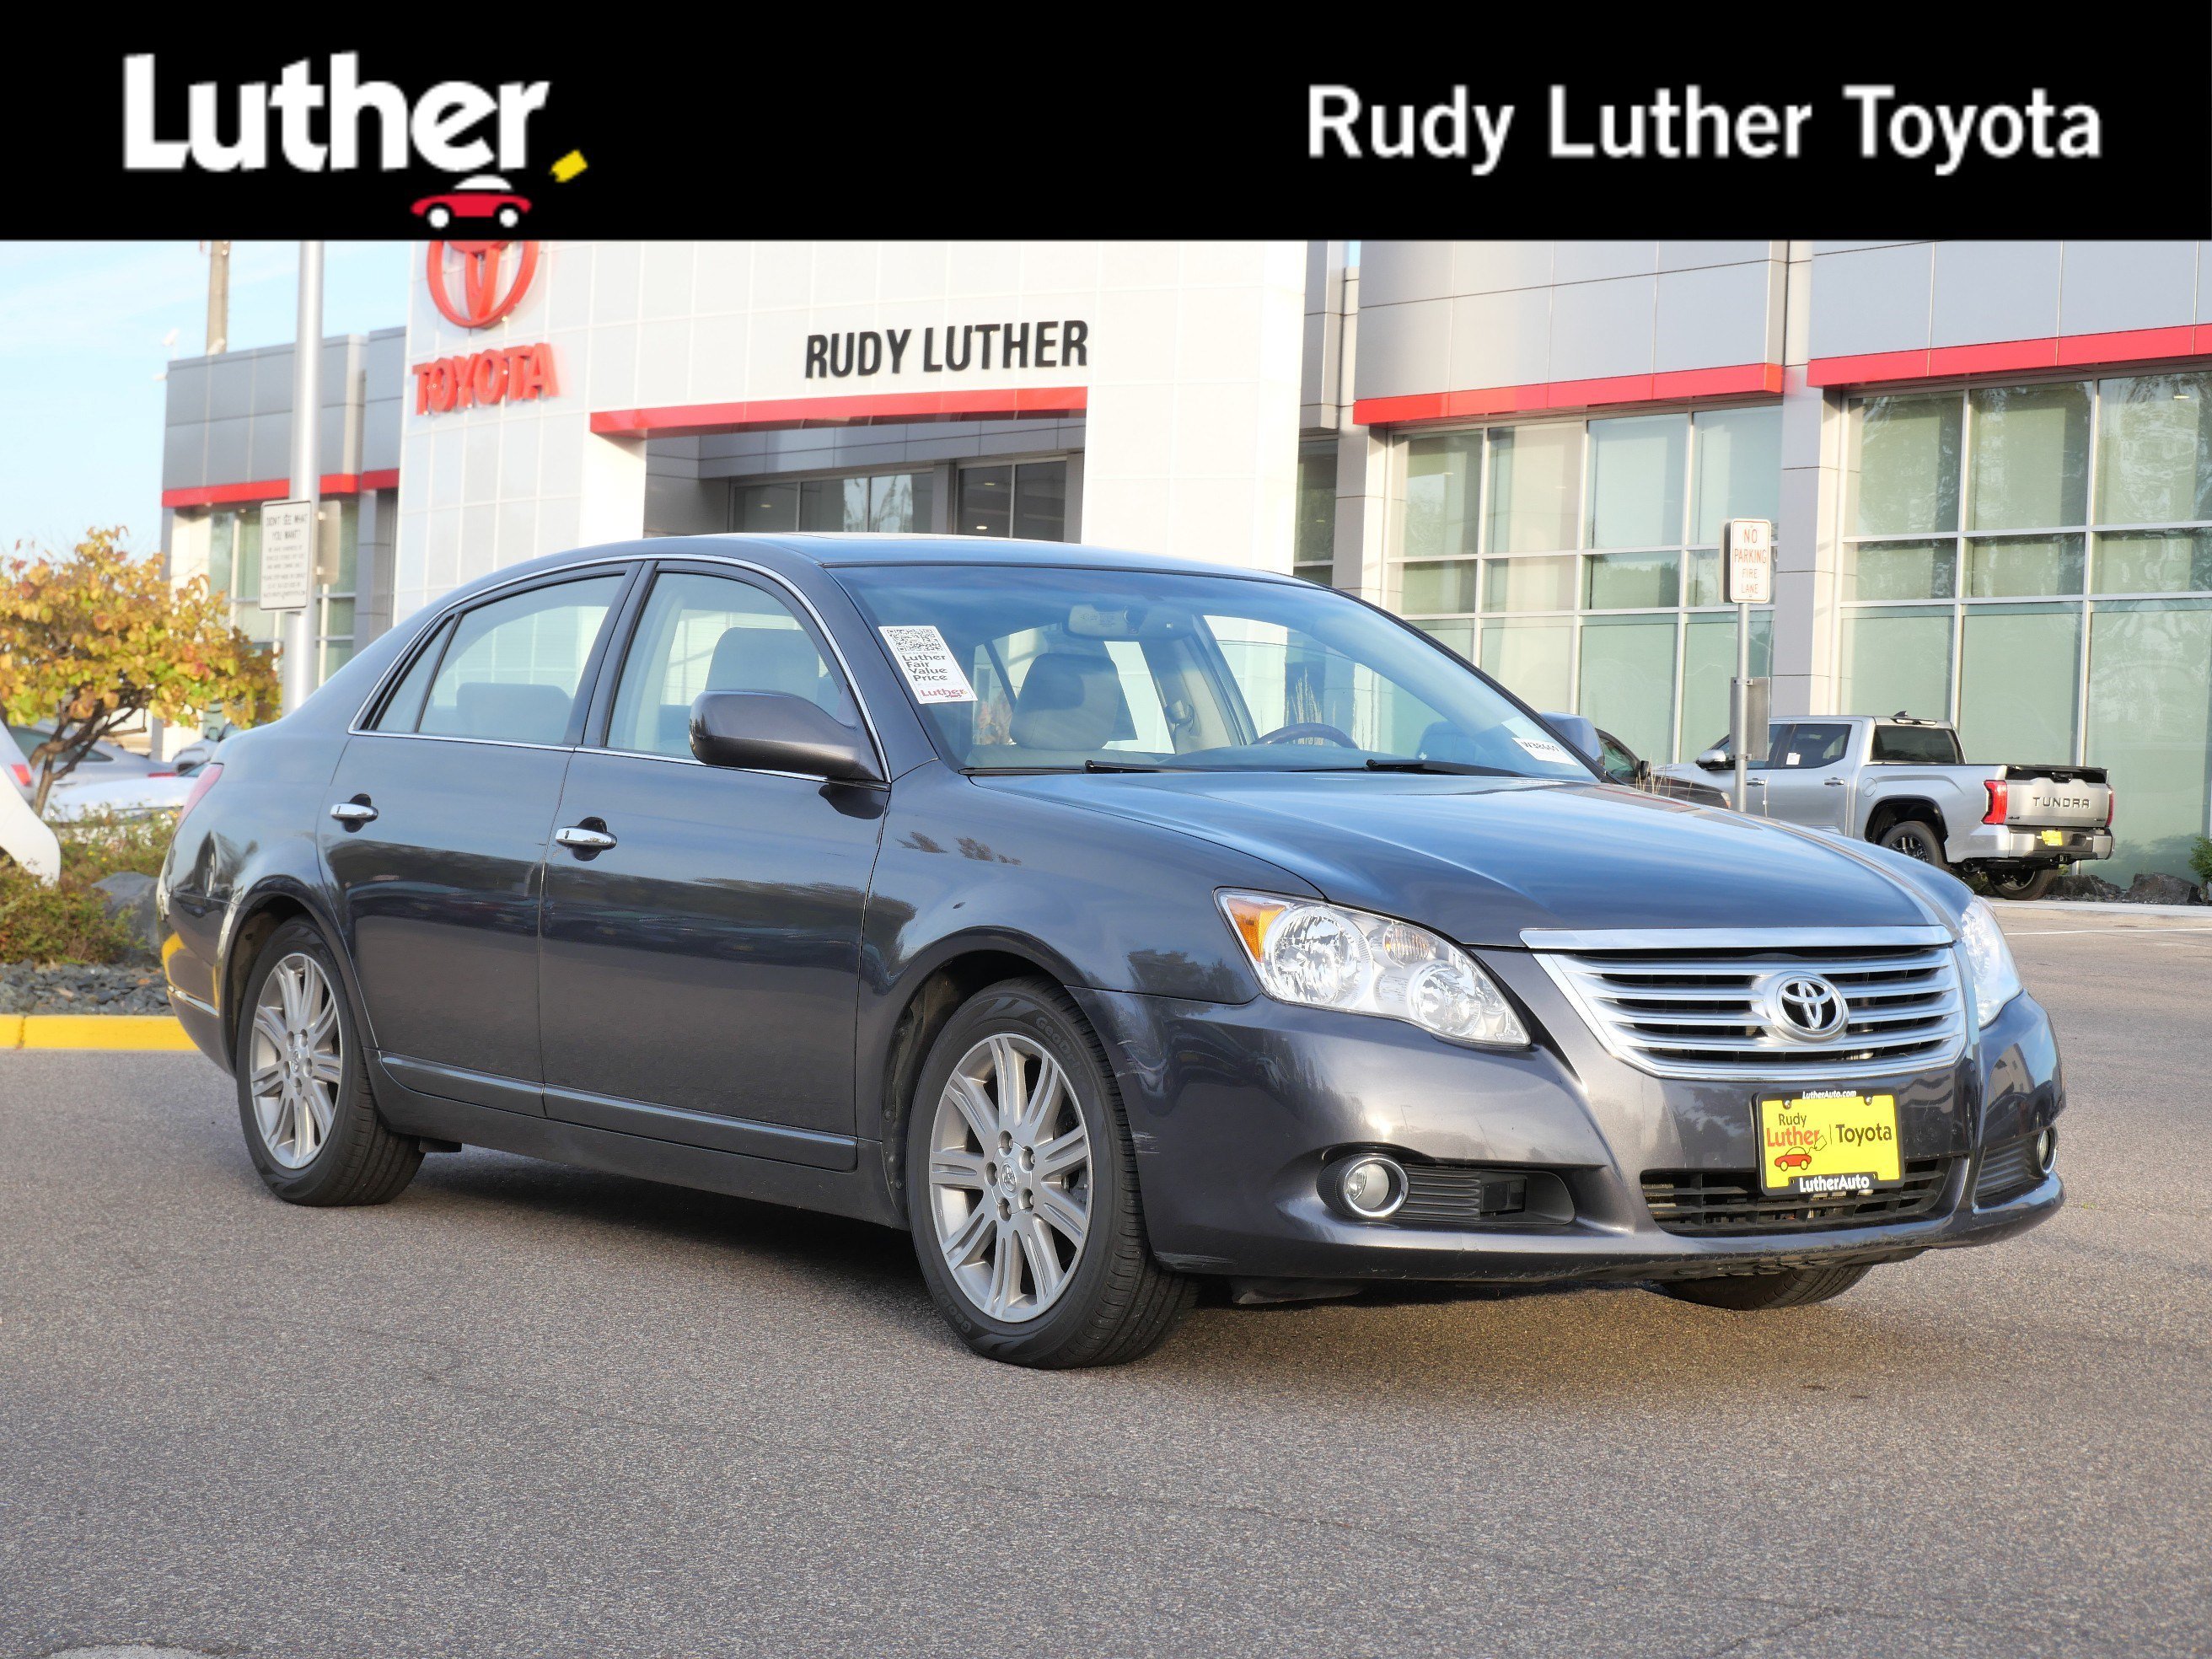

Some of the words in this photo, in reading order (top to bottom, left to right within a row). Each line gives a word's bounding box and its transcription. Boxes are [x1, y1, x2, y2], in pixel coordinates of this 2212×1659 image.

[805, 329, 912, 379] RUDY
[923, 319, 1088, 373] LUTHER
[412, 342, 560, 416] TOYOTA
[1743, 529, 1758, 544] NO
[1734, 548, 1767, 564] PARKING
[1742, 568, 1758, 578] FIRE
[1741, 583, 1758, 593] LANE
[912, 674, 948, 682] Price
[920, 688, 964, 697] Luther
[2033, 797, 2091, 808] TUNDRA
[1801, 1089, 1857, 1100] LutherAuto.com
[1778, 1112, 1807, 1128] Rudy
[1766, 1126, 1820, 1147] Luther
[1835, 1123, 1893, 1146] Toyota
[1799, 1173, 1871, 1193] LutherAuto
